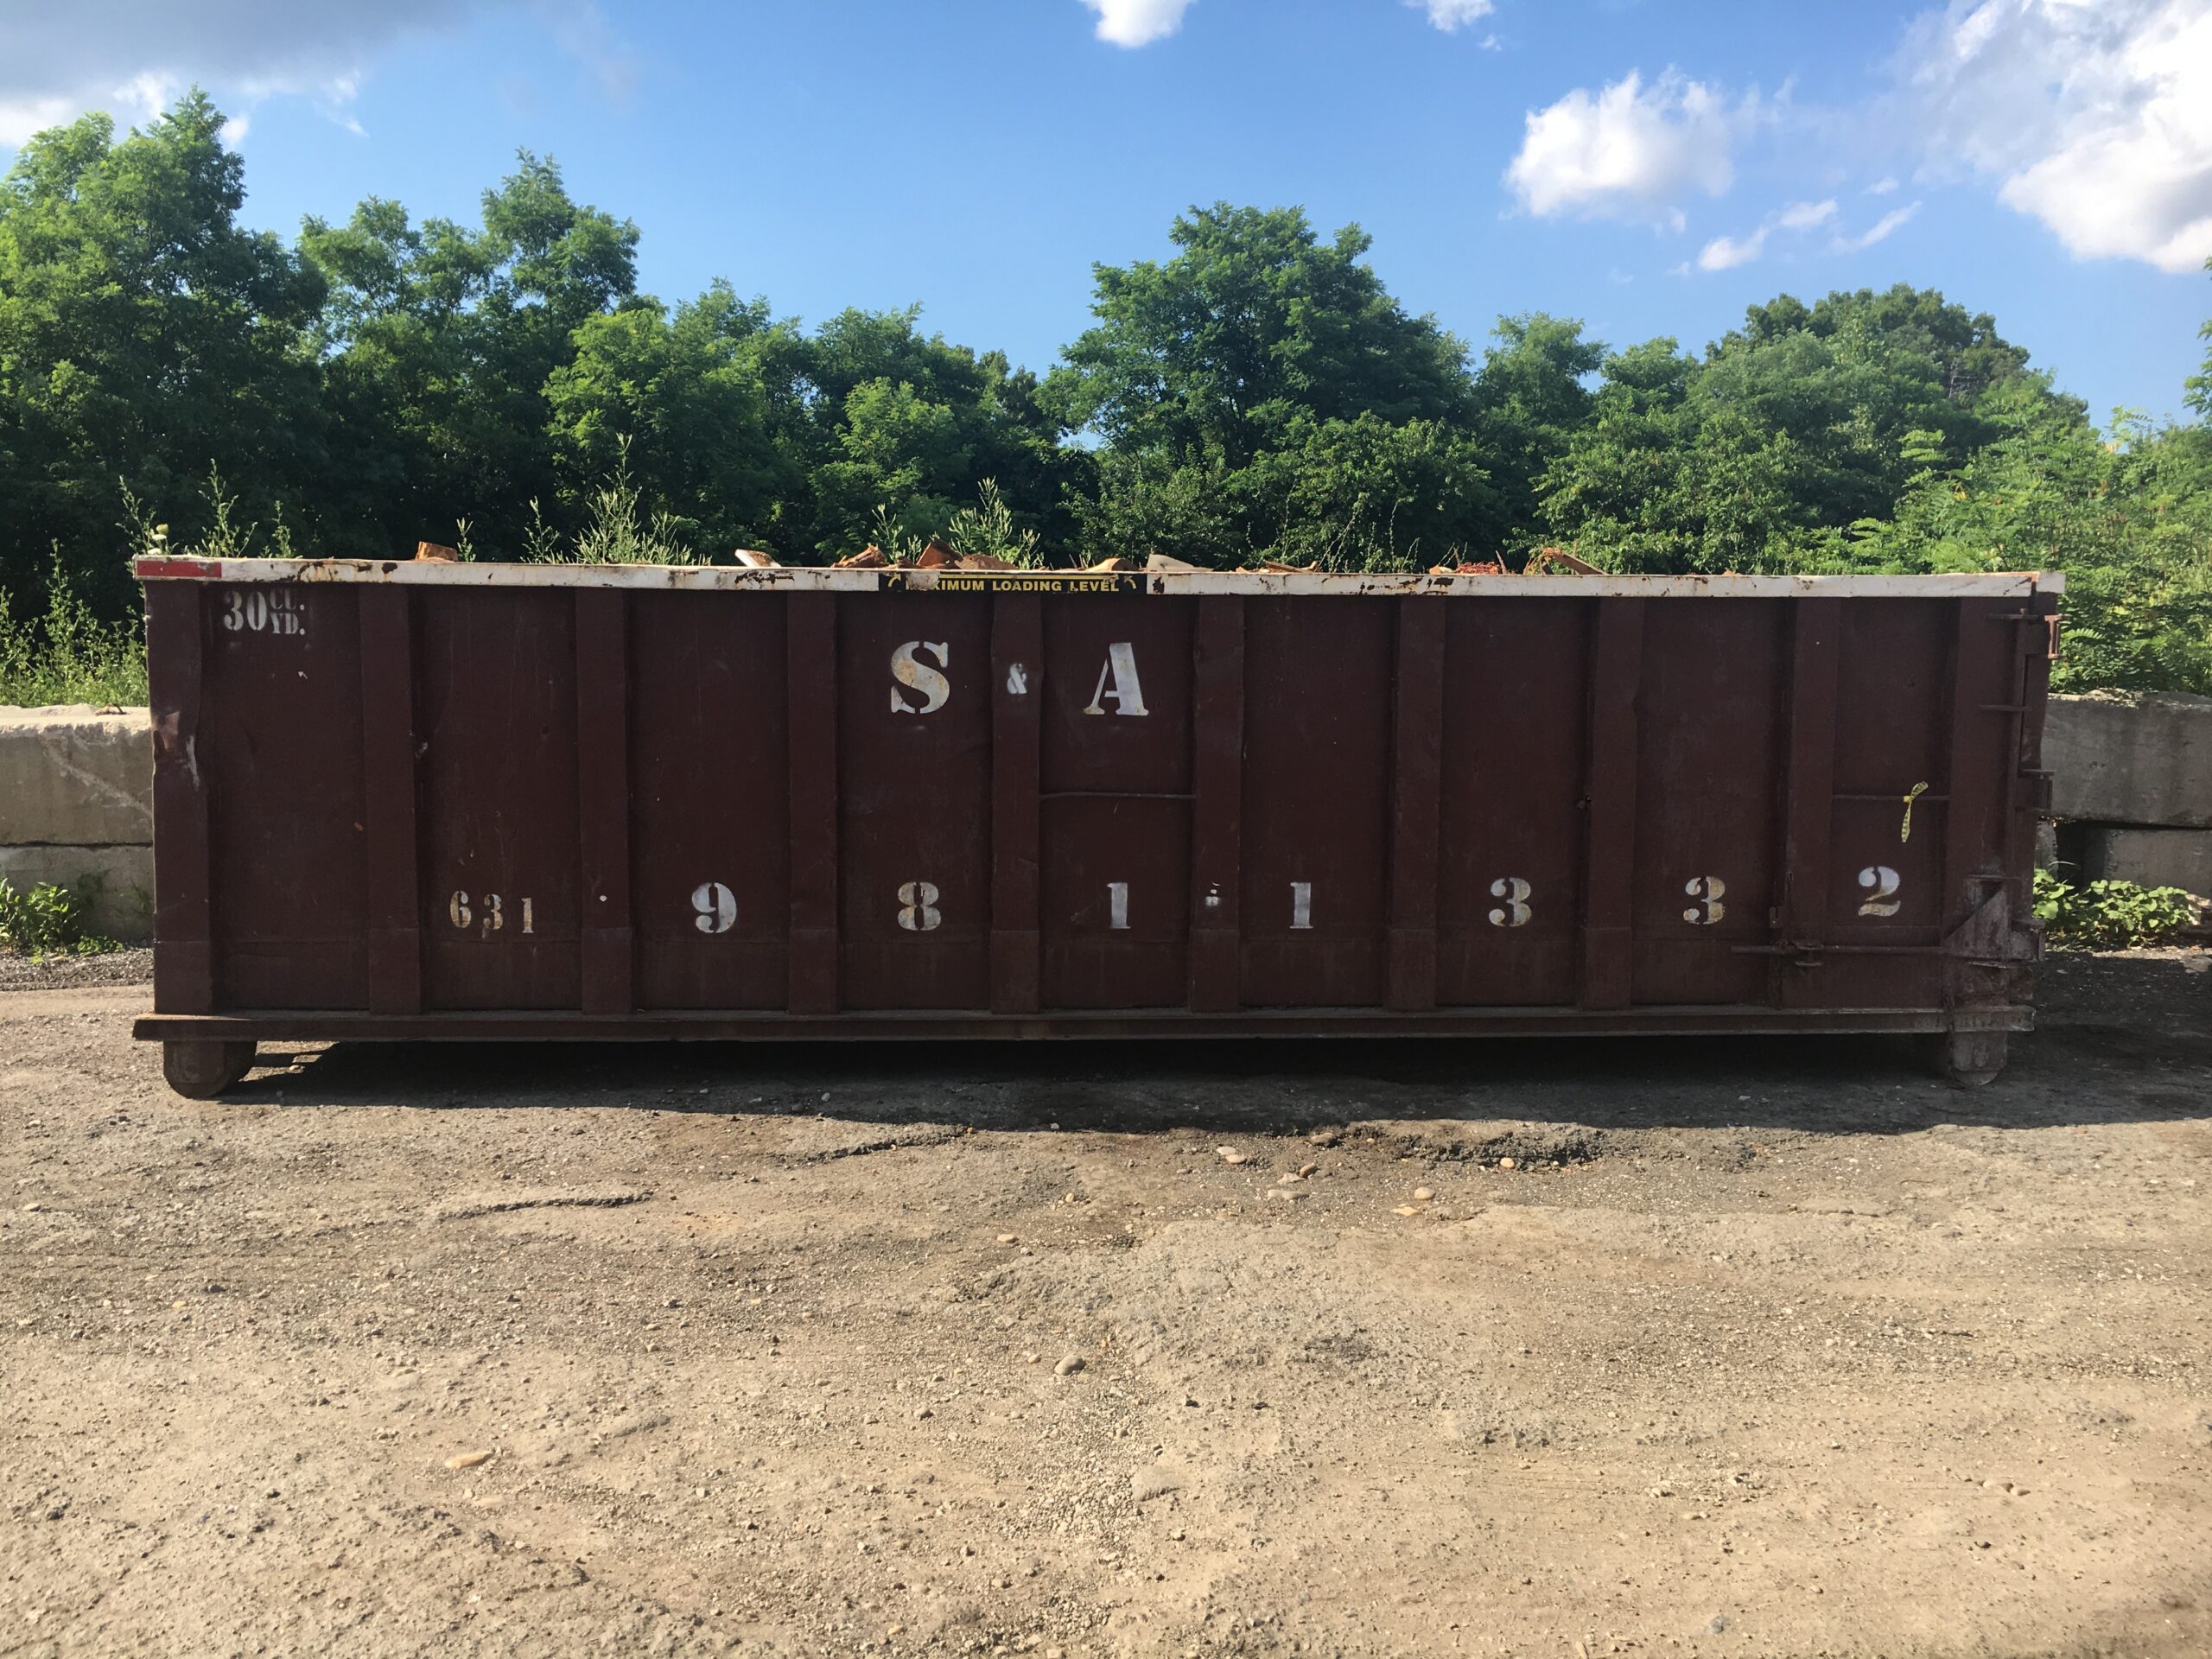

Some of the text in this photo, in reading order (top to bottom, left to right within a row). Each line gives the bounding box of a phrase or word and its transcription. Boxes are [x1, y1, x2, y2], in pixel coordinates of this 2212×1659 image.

[906, 580, 1120, 592] XIMUM LOADING LEVEL
[224, 590, 267, 631] 30
[270, 612, 306, 635] YD.
[891, 641, 950, 714] S
[1084, 642, 1148, 715] A
[449, 890, 534, 933] 631
